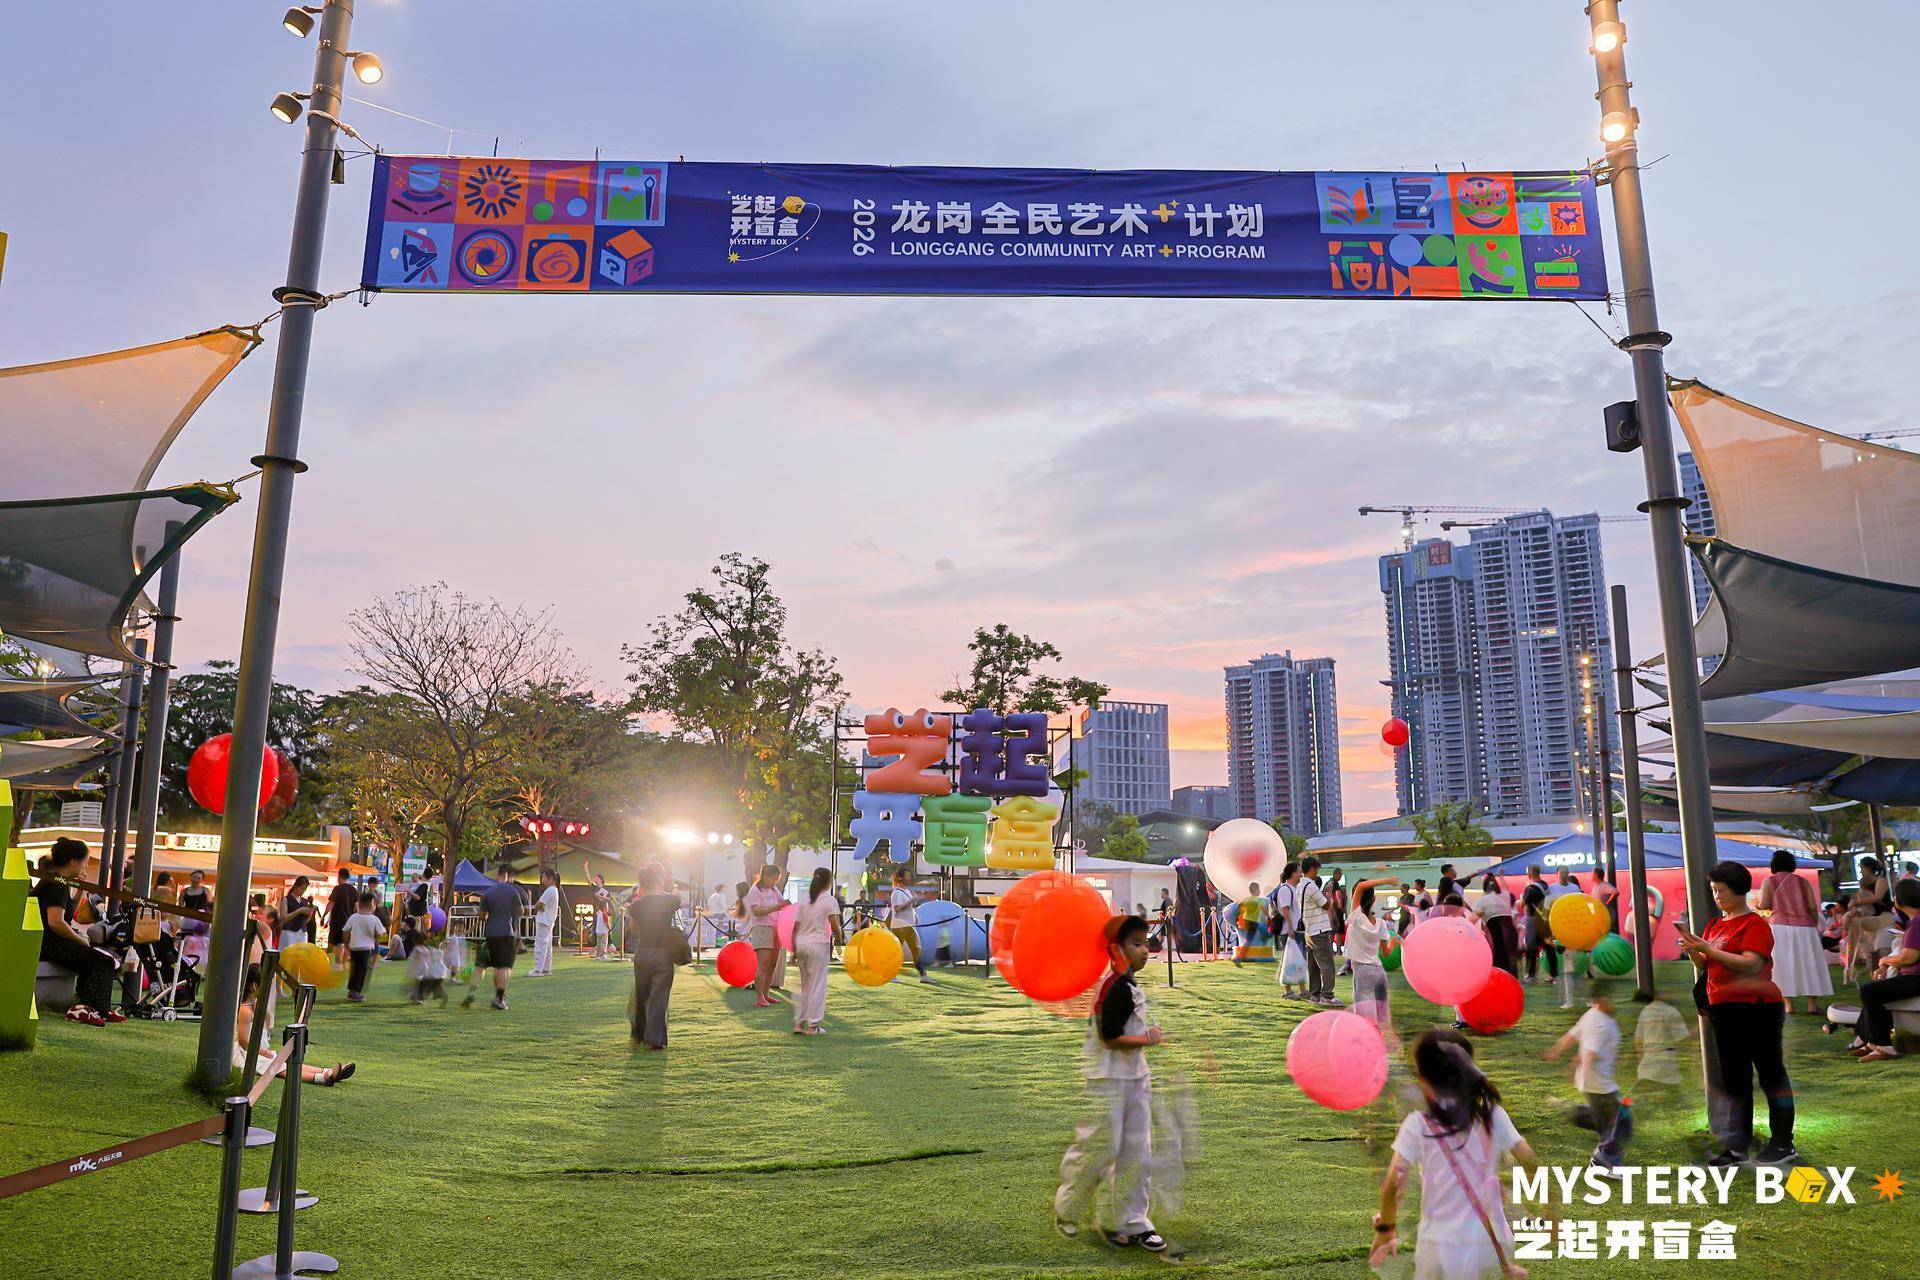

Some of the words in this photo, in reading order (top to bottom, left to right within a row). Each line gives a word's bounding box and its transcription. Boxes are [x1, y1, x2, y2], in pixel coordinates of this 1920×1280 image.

[729, 238, 768, 246] MYSTERY
[770, 238, 788, 246] BOX
[730, 216, 799, 237] 开盲盒
[852, 198, 876, 257] 2026
[890, 241, 995, 257] LONGGANG
[1000, 242, 1115, 258] COMMUNITY
[864, 707, 1050, 797] 艺起
[850, 789, 1060, 871] 开盲盒
